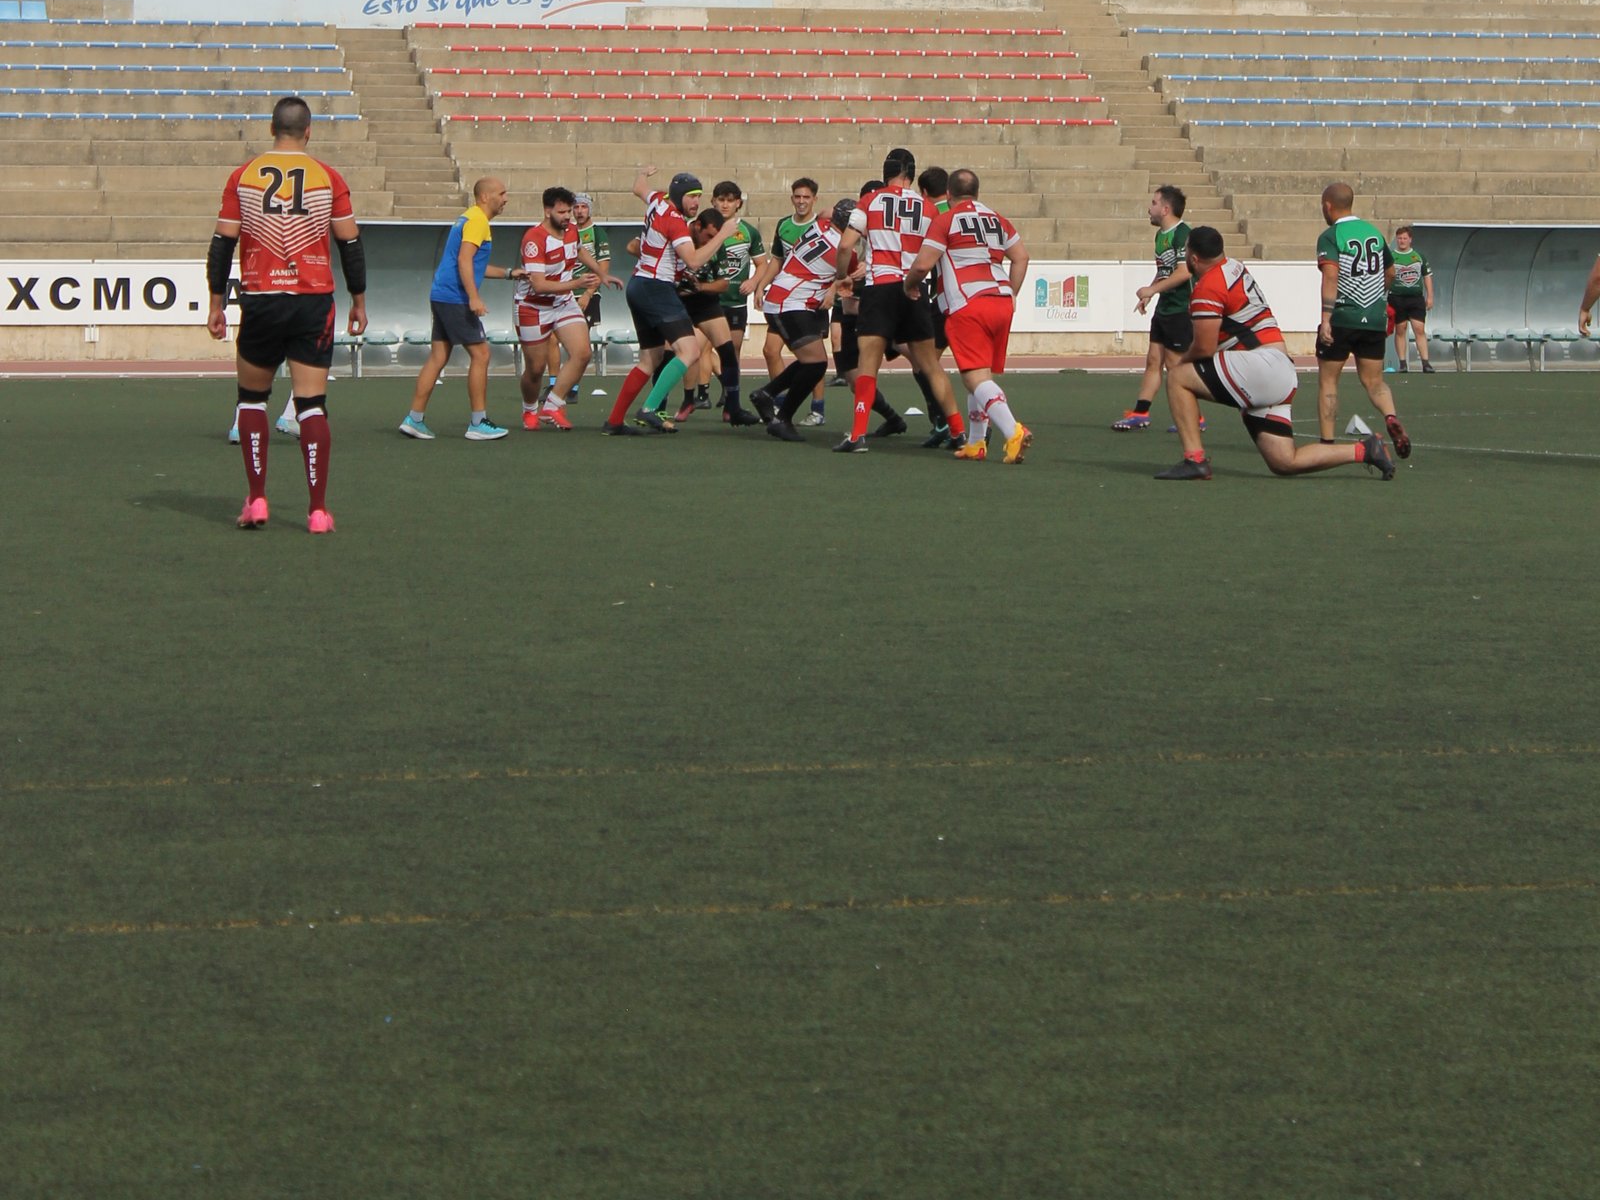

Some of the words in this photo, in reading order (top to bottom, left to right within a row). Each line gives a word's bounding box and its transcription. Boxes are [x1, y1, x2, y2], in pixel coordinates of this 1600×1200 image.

[259, 165, 310, 216] 21
[880, 195, 922, 232] 14
[959, 216, 1006, 246] 44
[1348, 237, 1381, 278] 26
[250, 432, 261, 475] MORLEY
[308, 443, 318, 487] MORLEY
